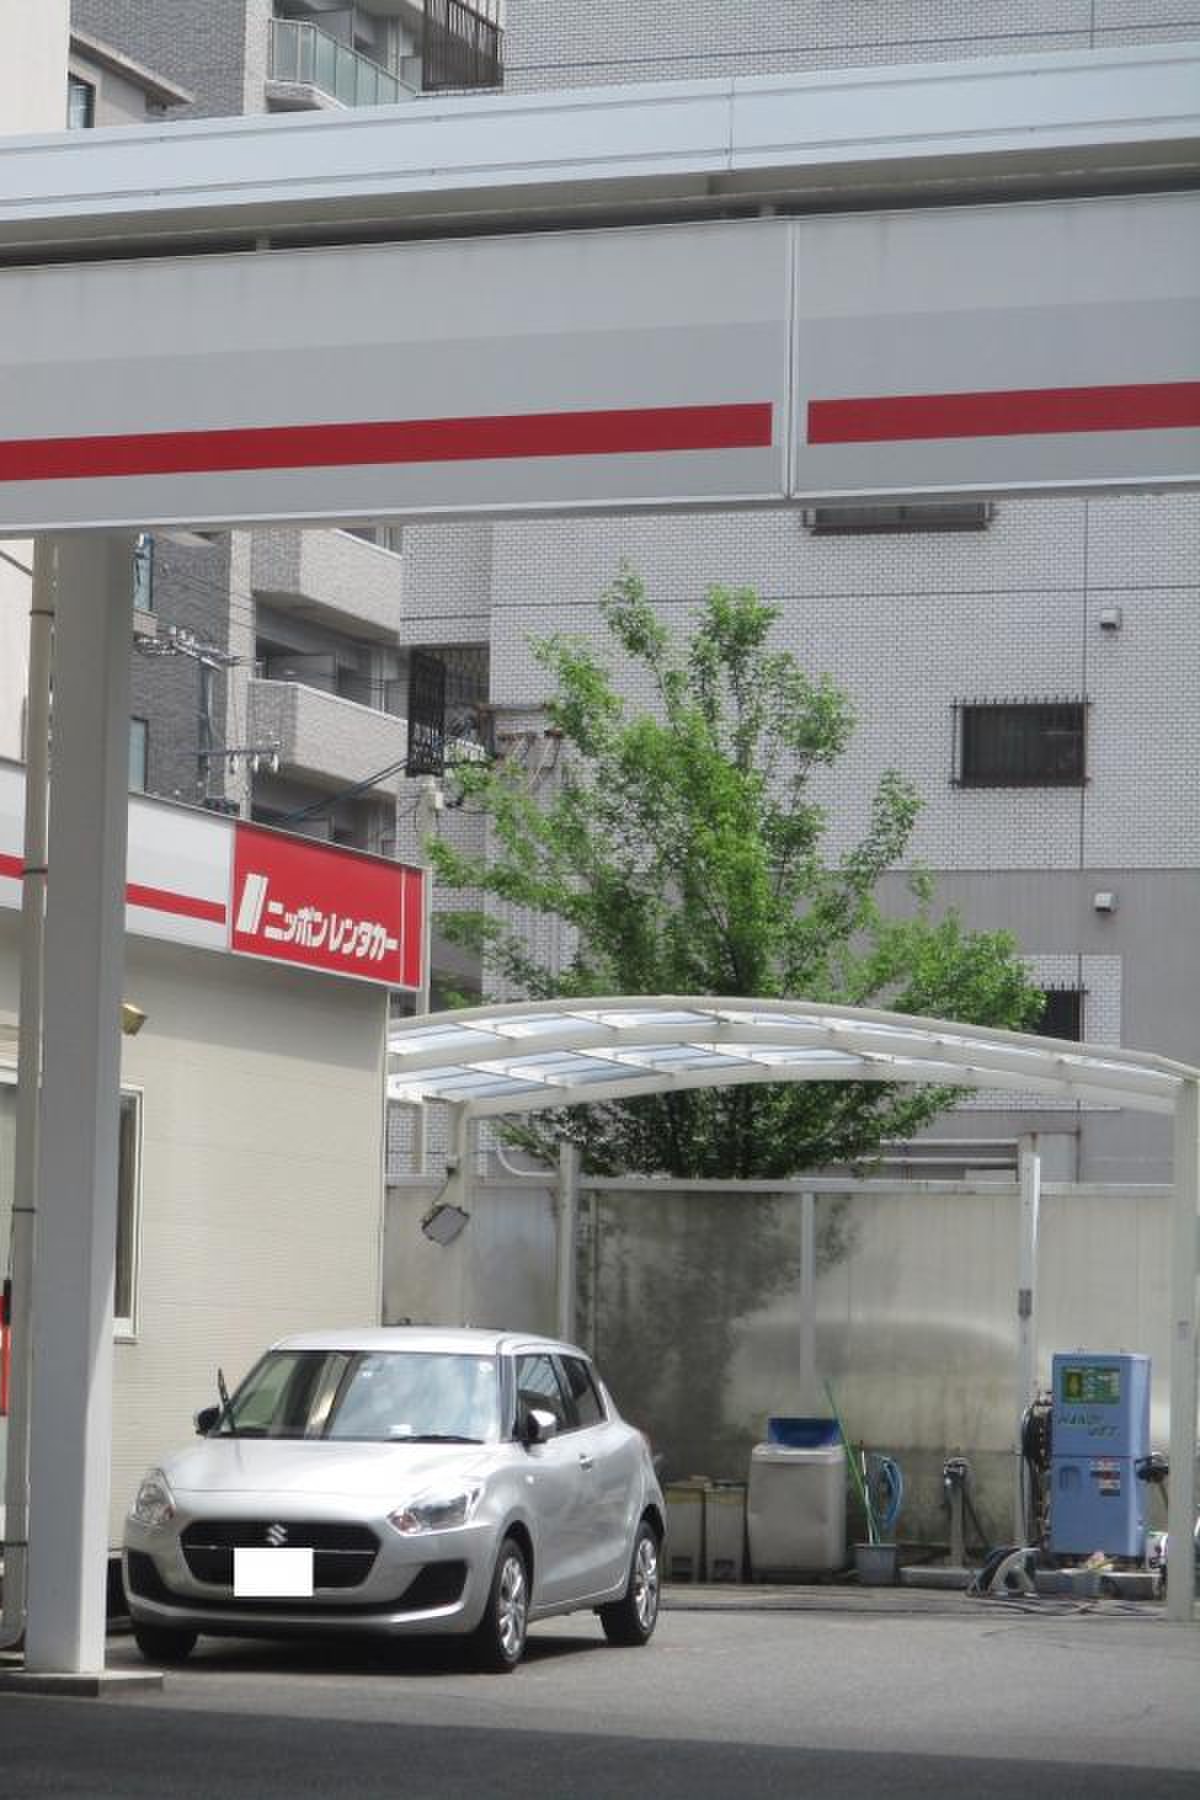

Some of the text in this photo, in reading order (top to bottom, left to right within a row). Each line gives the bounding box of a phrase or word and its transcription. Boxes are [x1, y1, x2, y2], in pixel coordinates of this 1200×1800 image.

[264, 900, 399, 960] ニッポンレンタカー
